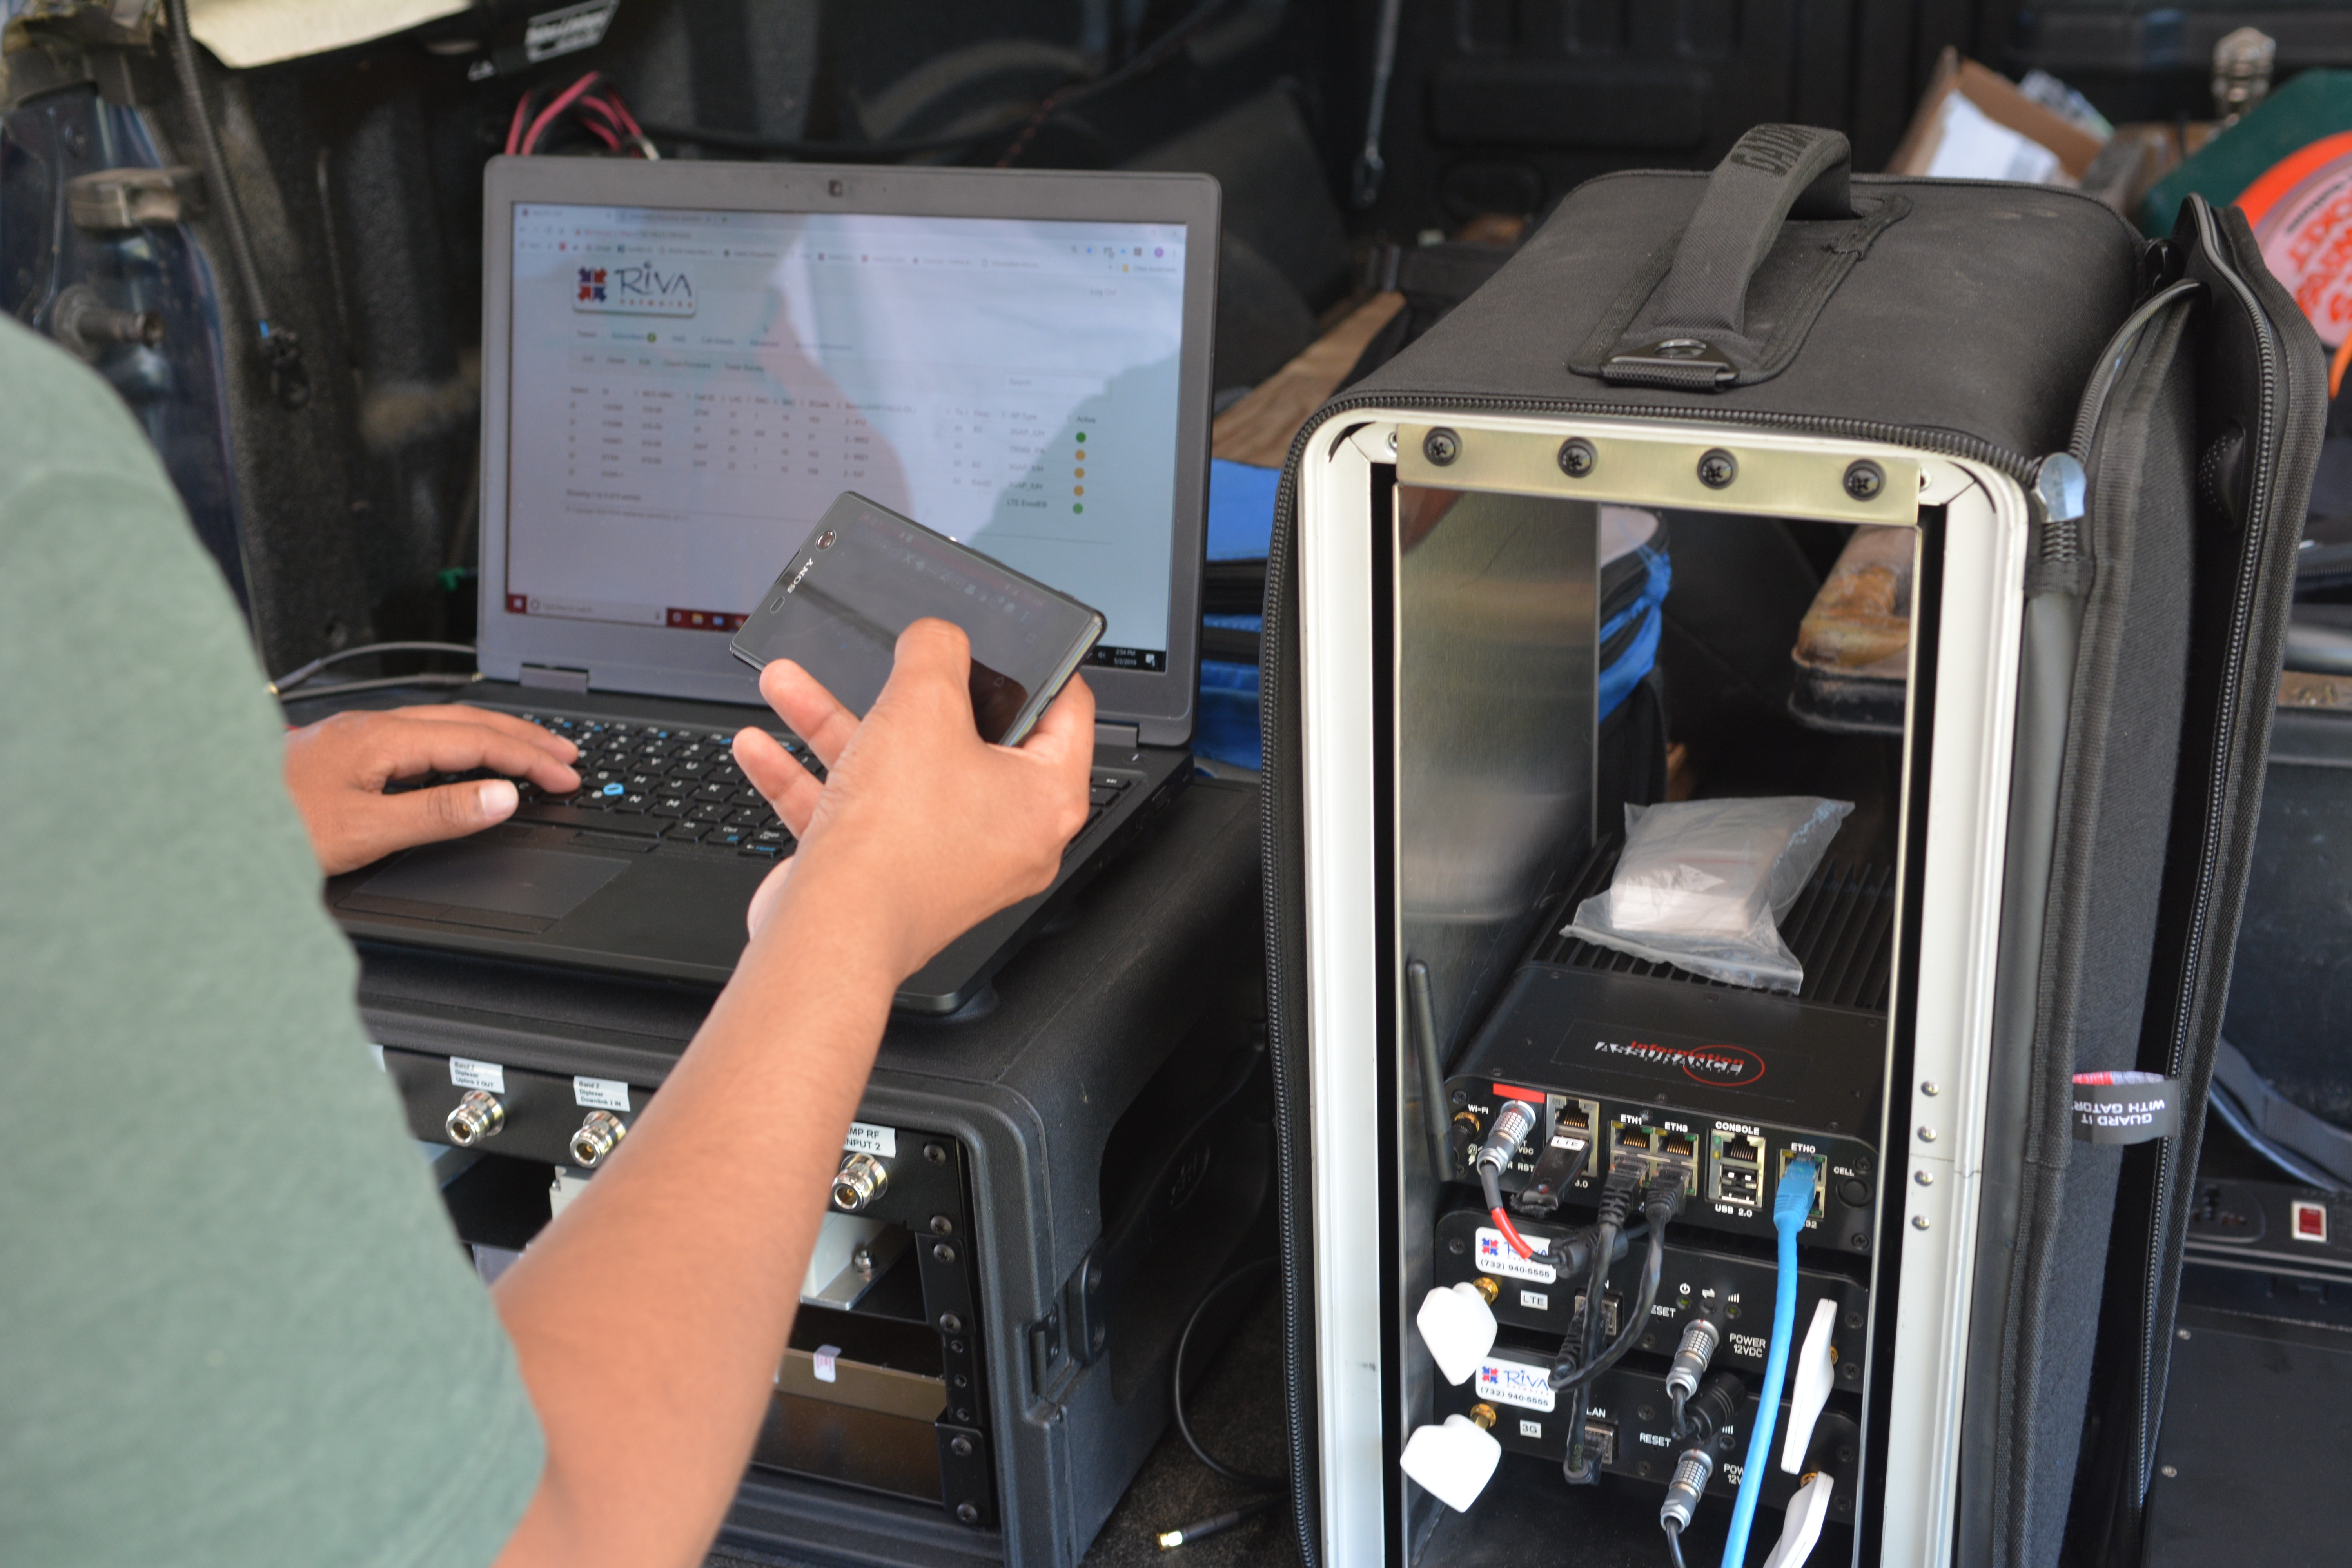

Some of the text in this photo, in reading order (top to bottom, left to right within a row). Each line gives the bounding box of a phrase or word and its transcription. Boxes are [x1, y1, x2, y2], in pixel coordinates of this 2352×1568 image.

[787, 557, 813, 593] SONY
[1631, 1041, 1745, 1065] Information
[579, 1089, 603, 1097] Diplexer
[581, 1097, 608, 1105] Downlink
[2129, 1099, 2165, 1114] WITH
[1468, 1103, 1489, 1115] WI-FI
[1621, 1114, 1642, 1125] ETH1
[2081, 1113, 2152, 1127] GUARD IT
[848, 1127, 880, 1139] MP RF
[1715, 1121, 1760, 1136] CONSOLE
[875, 1142, 881, 1151] 2
[1556, 1140, 1579, 1148] LTE
[1833, 1166, 1855, 1176] CELL
[1715, 1203, 1753, 1218] USB 2.0
[1481, 1258, 1505, 1270] (732)
[1509, 1265, 1550, 1278] 940-5555
[1523, 1294, 1544, 1306] LTE
[1650, 1304, 1676, 1318] ESET
[1730, 1332, 1766, 1349] POWER
[1733, 1343, 1763, 1358] 12VDC
[1481, 1386, 1548, 1407] (732) 940-5555
[1586, 1406, 1606, 1419] LAN
[1522, 1423, 1537, 1434] 3G
[1639, 1432, 1671, 1448] RESET
[1724, 1463, 1744, 1476] POW
[1727, 1474, 1743, 1486] 12V
